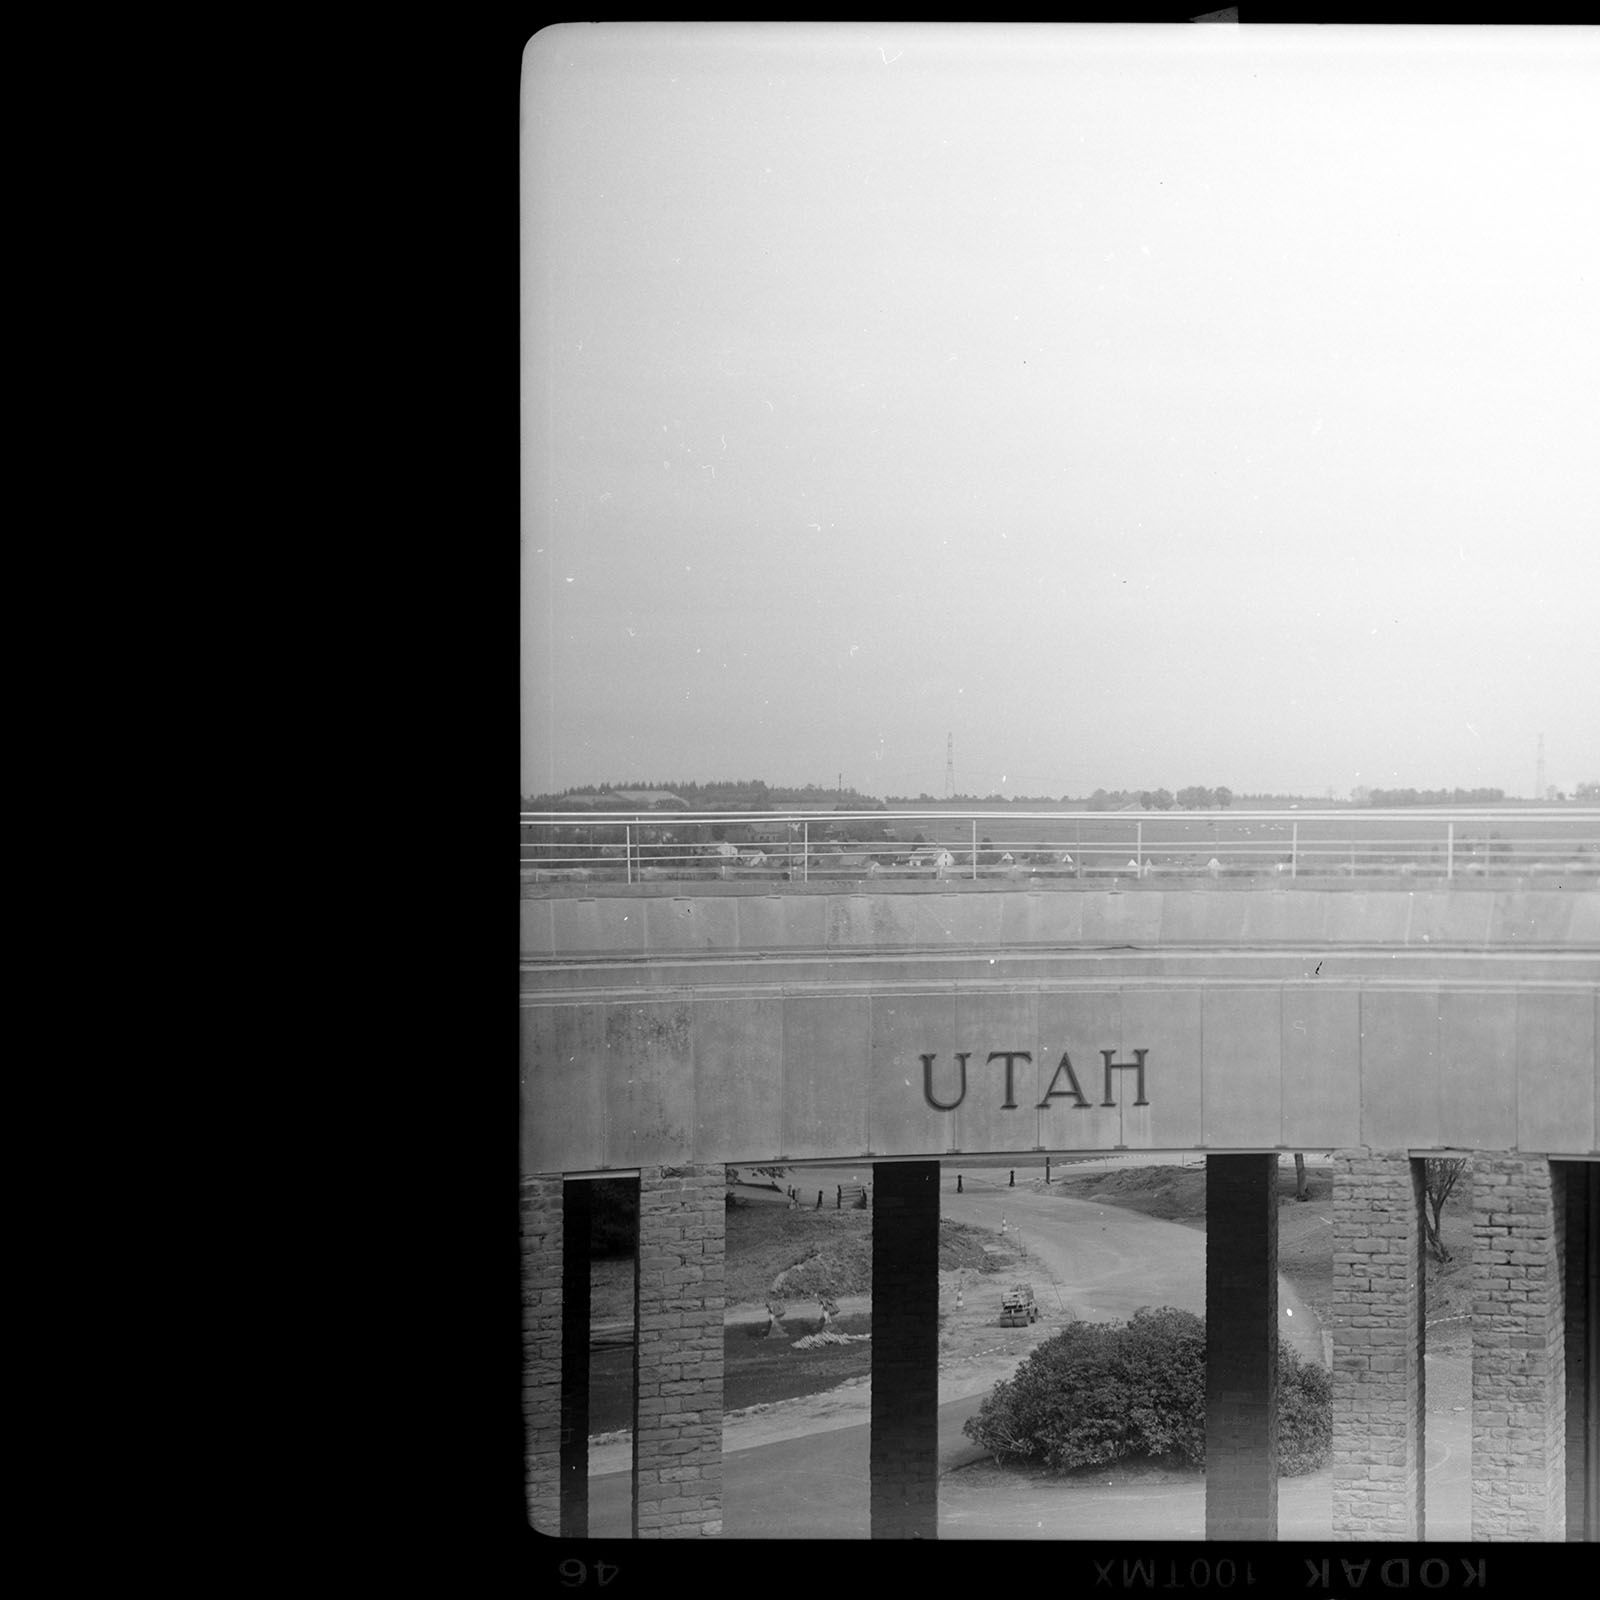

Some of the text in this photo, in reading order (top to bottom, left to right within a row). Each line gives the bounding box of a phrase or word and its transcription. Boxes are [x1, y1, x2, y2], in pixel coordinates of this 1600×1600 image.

[918, 1047, 1151, 1112] UTAH
[558, 1558, 620, 1588] 46
[1093, 1558, 1487, 1589] KODAK 100TMX
